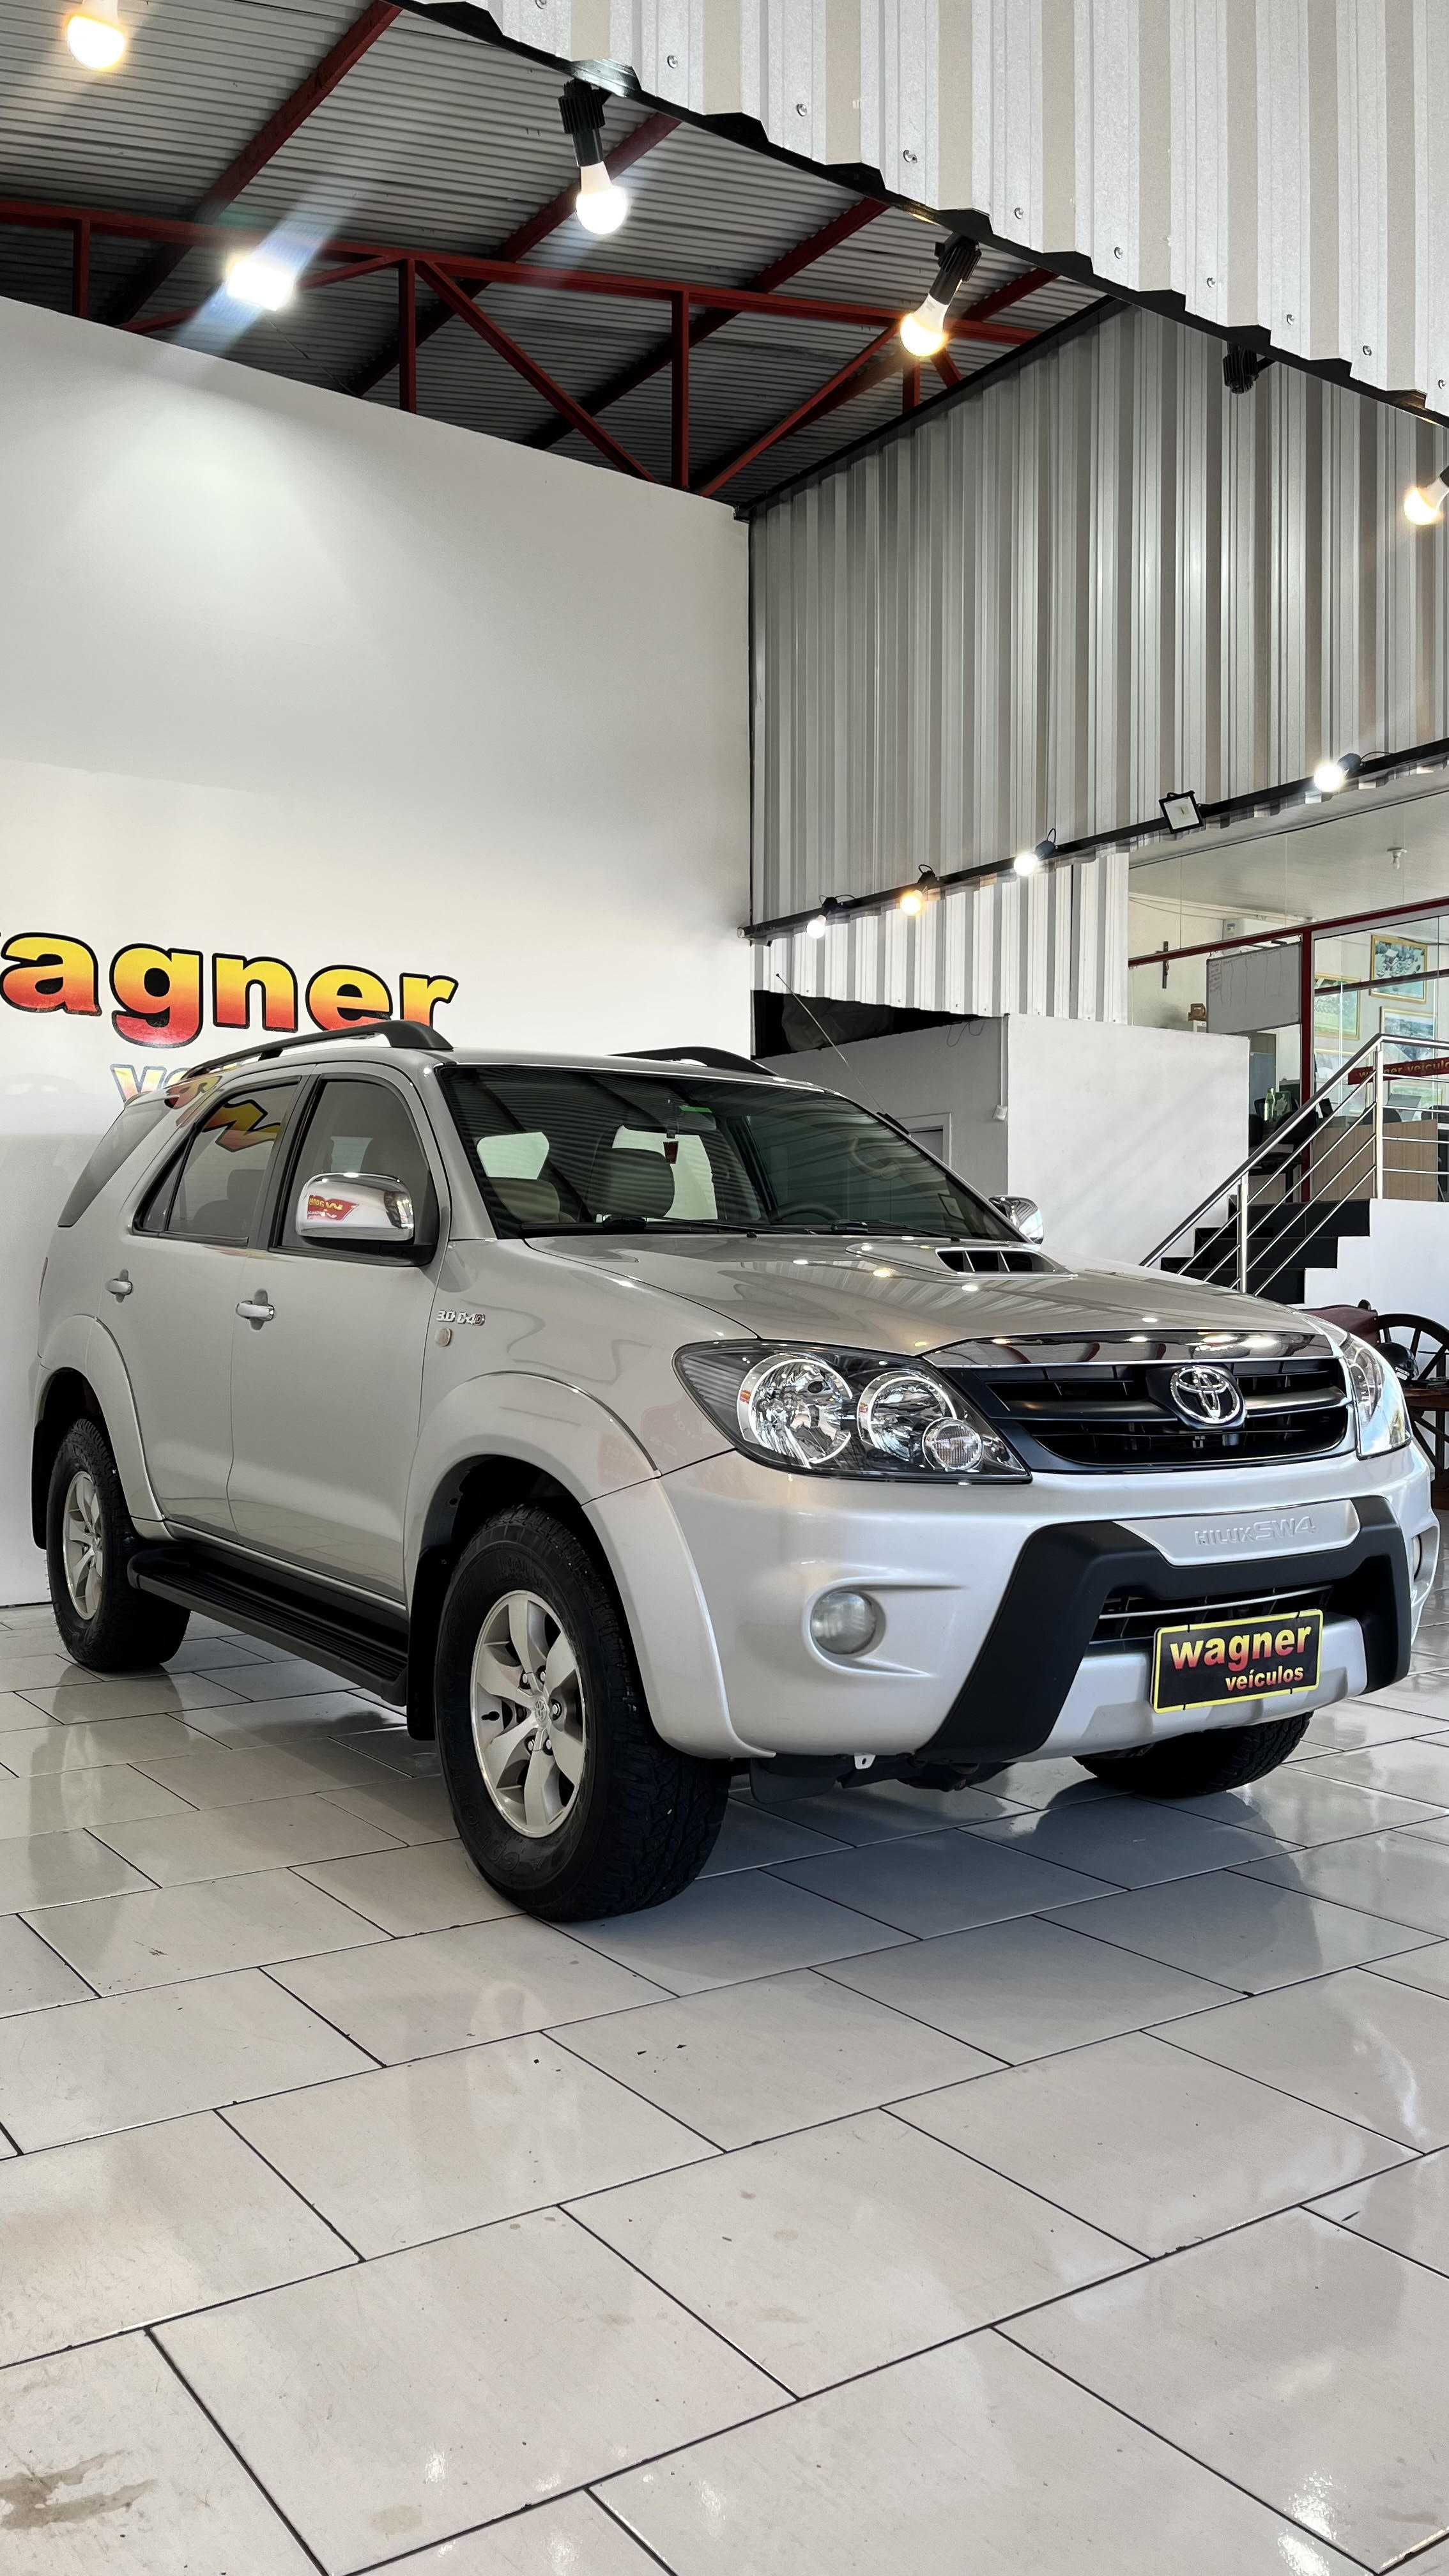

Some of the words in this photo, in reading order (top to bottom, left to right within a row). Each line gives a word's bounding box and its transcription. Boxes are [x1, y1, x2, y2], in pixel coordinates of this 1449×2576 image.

[0, 931, 459, 1048] agner
[1194, 1526, 1254, 1545] HILUX
[1254, 1516, 1315, 1540] SW4
[1170, 1626, 1312, 1672] wagner
[1225, 1666, 1304, 1691] veículos
